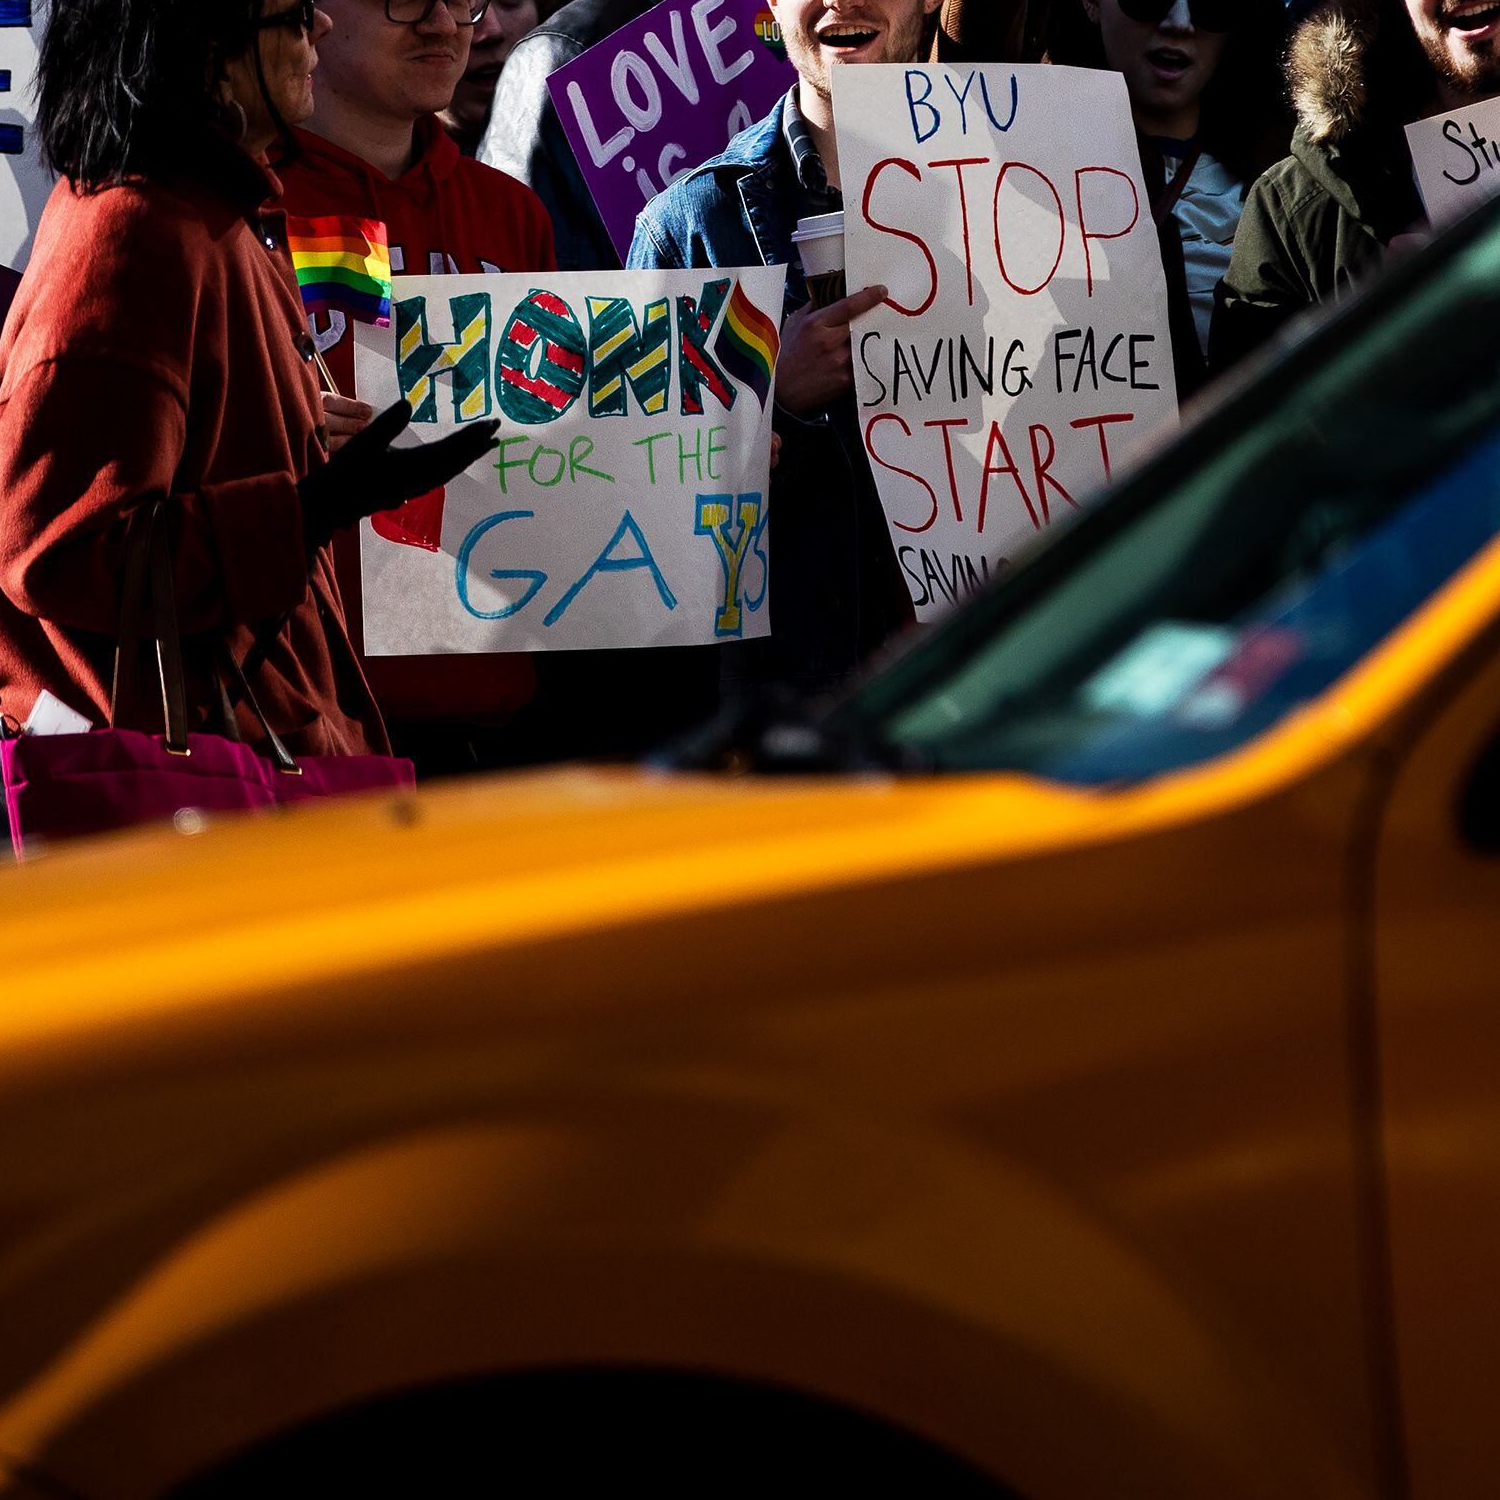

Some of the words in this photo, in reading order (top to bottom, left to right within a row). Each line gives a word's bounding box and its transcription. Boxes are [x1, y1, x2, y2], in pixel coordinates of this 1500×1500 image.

[904, 70, 1019, 143] BYU
[861, 157, 1139, 317] STOP
[395, 278, 738, 424] HONK
[860, 331, 1033, 408] SAVING
[1054, 328, 1160, 393] FACE
[494, 435, 615, 495] FOR
[633, 426, 728, 485] THE
[865, 412, 1134, 534] START
